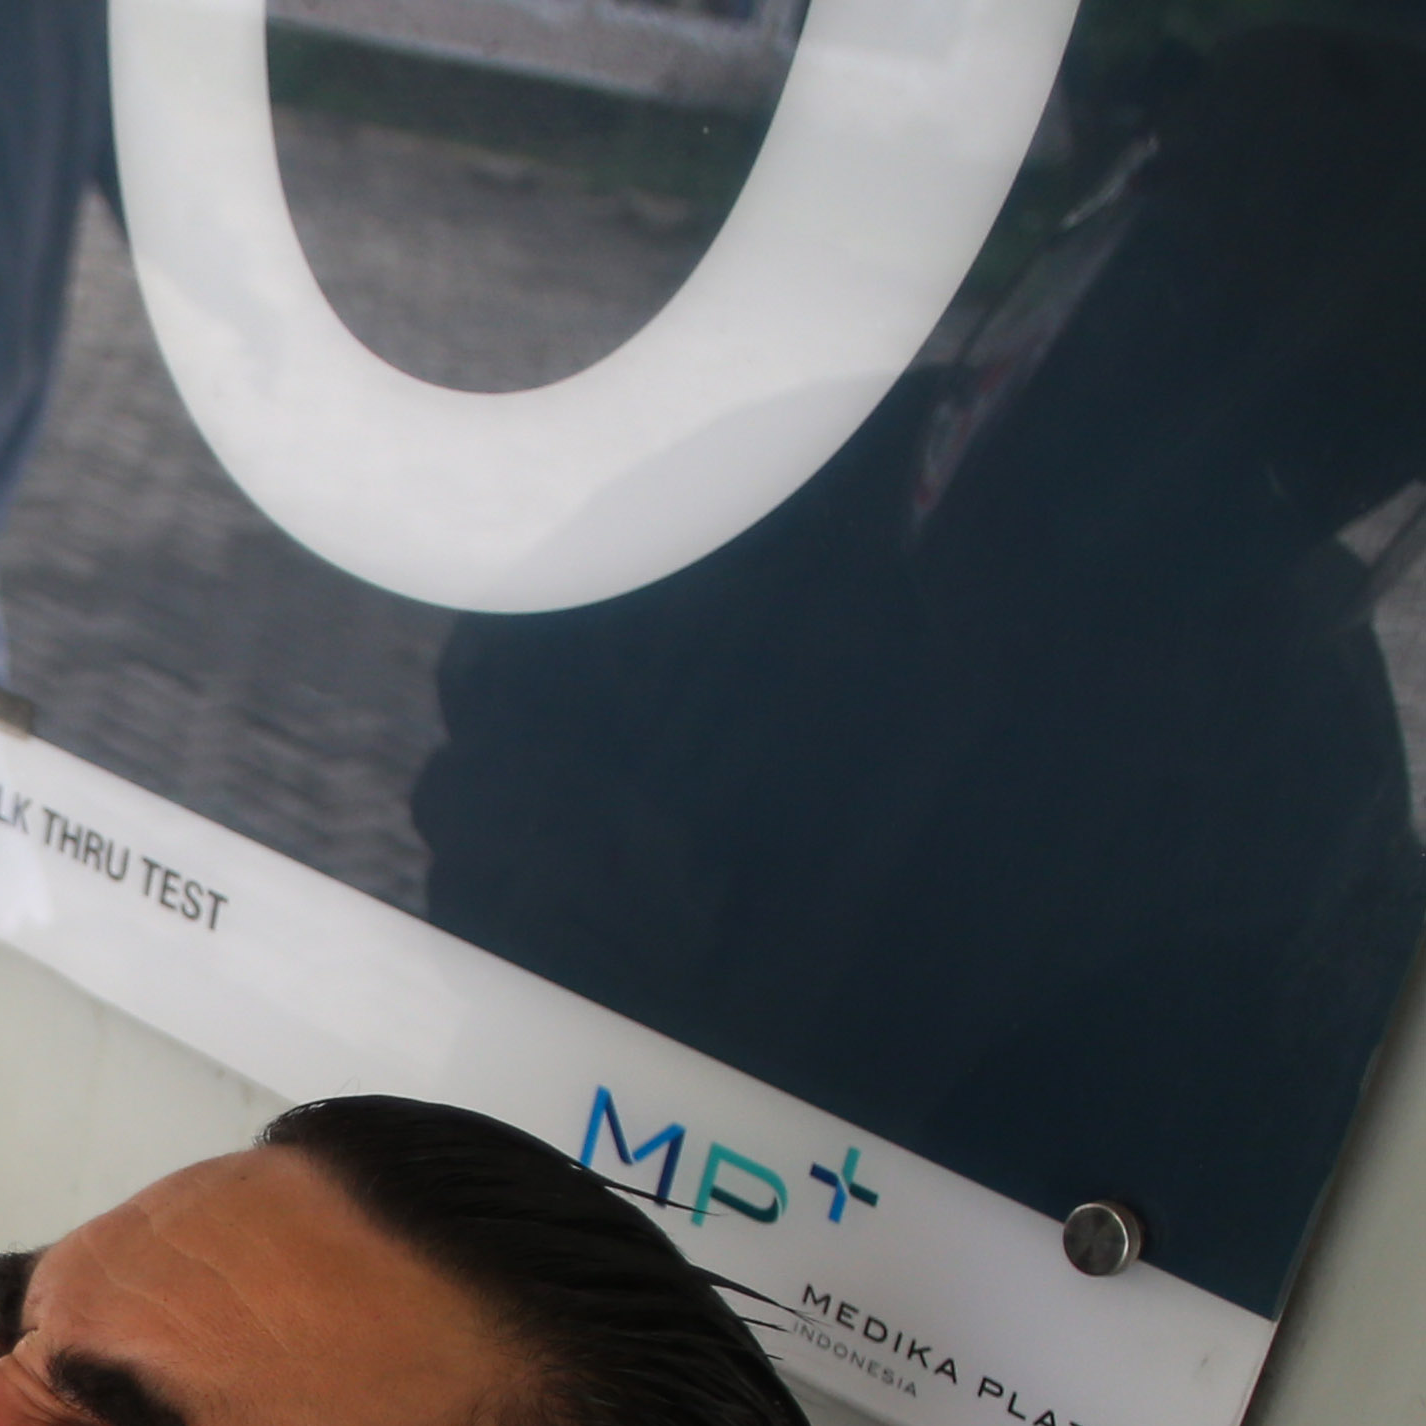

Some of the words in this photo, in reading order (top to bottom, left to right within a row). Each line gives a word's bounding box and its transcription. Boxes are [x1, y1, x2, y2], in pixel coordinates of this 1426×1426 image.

[42, 806, 132, 882] THRU
[140, 855, 229, 931] TEST
[792, 1320, 917, 1398] INDONESIA
[801, 1282, 958, 1385] MEDIKA
